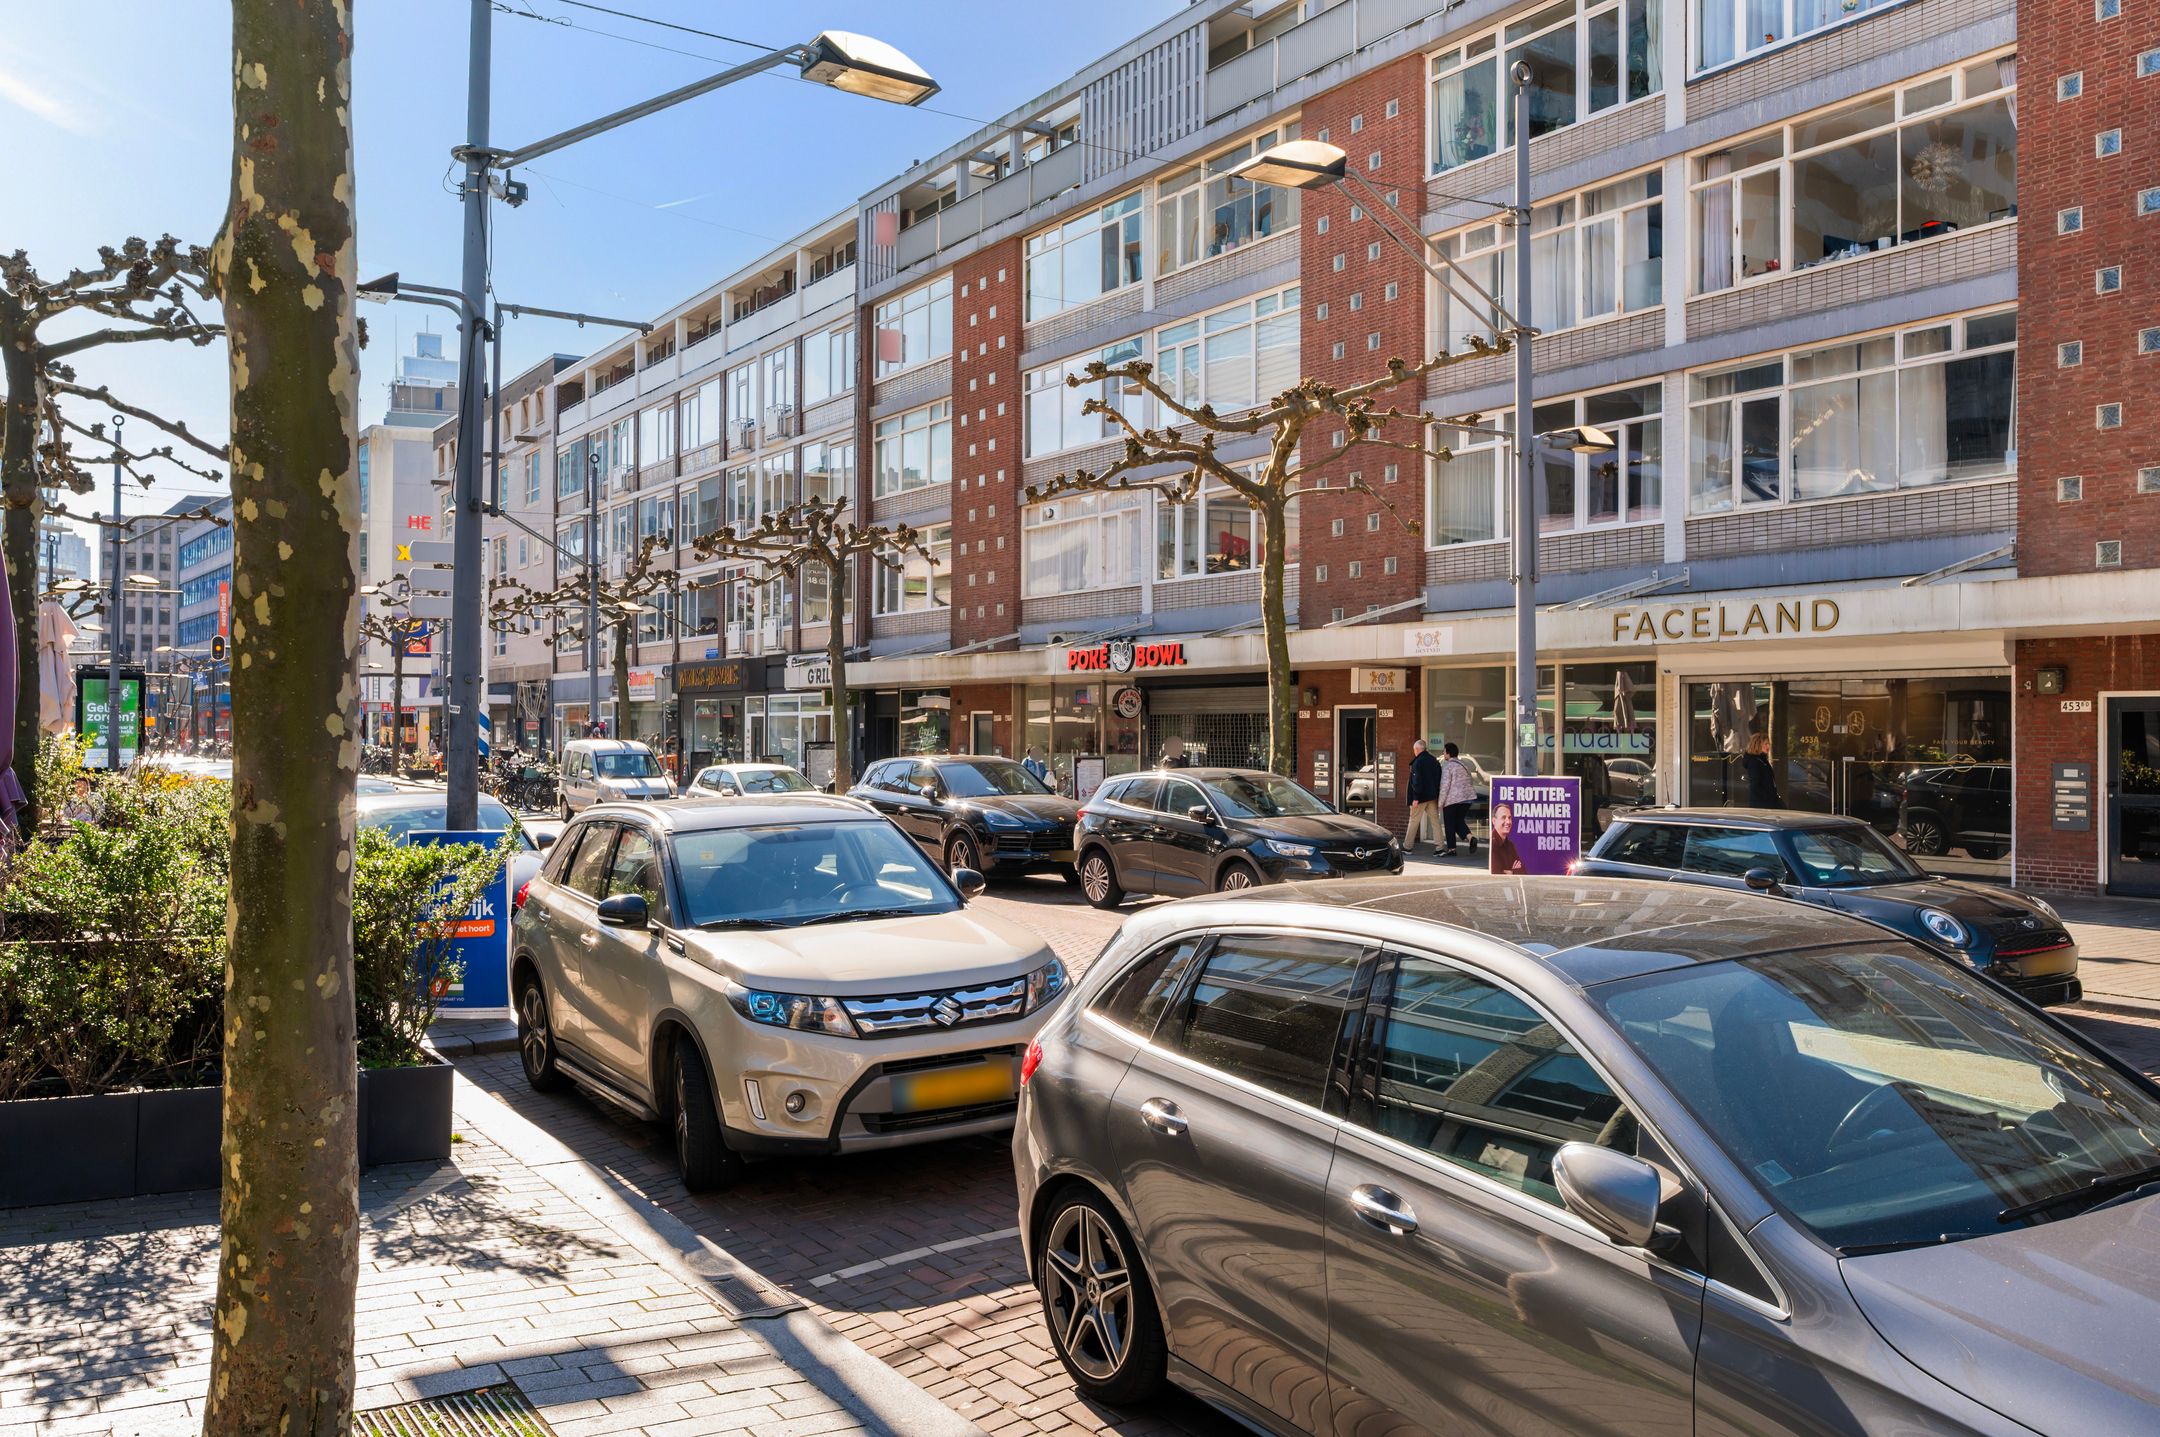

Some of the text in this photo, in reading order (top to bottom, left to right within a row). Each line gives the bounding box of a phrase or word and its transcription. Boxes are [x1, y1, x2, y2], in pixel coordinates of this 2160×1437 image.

[1612, 599, 1840, 641] FACELAND
[1068, 642, 1184, 671] POKÉ BOWL
[1500, 787, 1571, 801] DE ROTTER-
[1513, 803, 1571, 818] DAMMER
[1517, 820, 1570, 834] AAN HET
[1537, 836, 1571, 851] ROER
[468, 925, 490, 933] hoort
